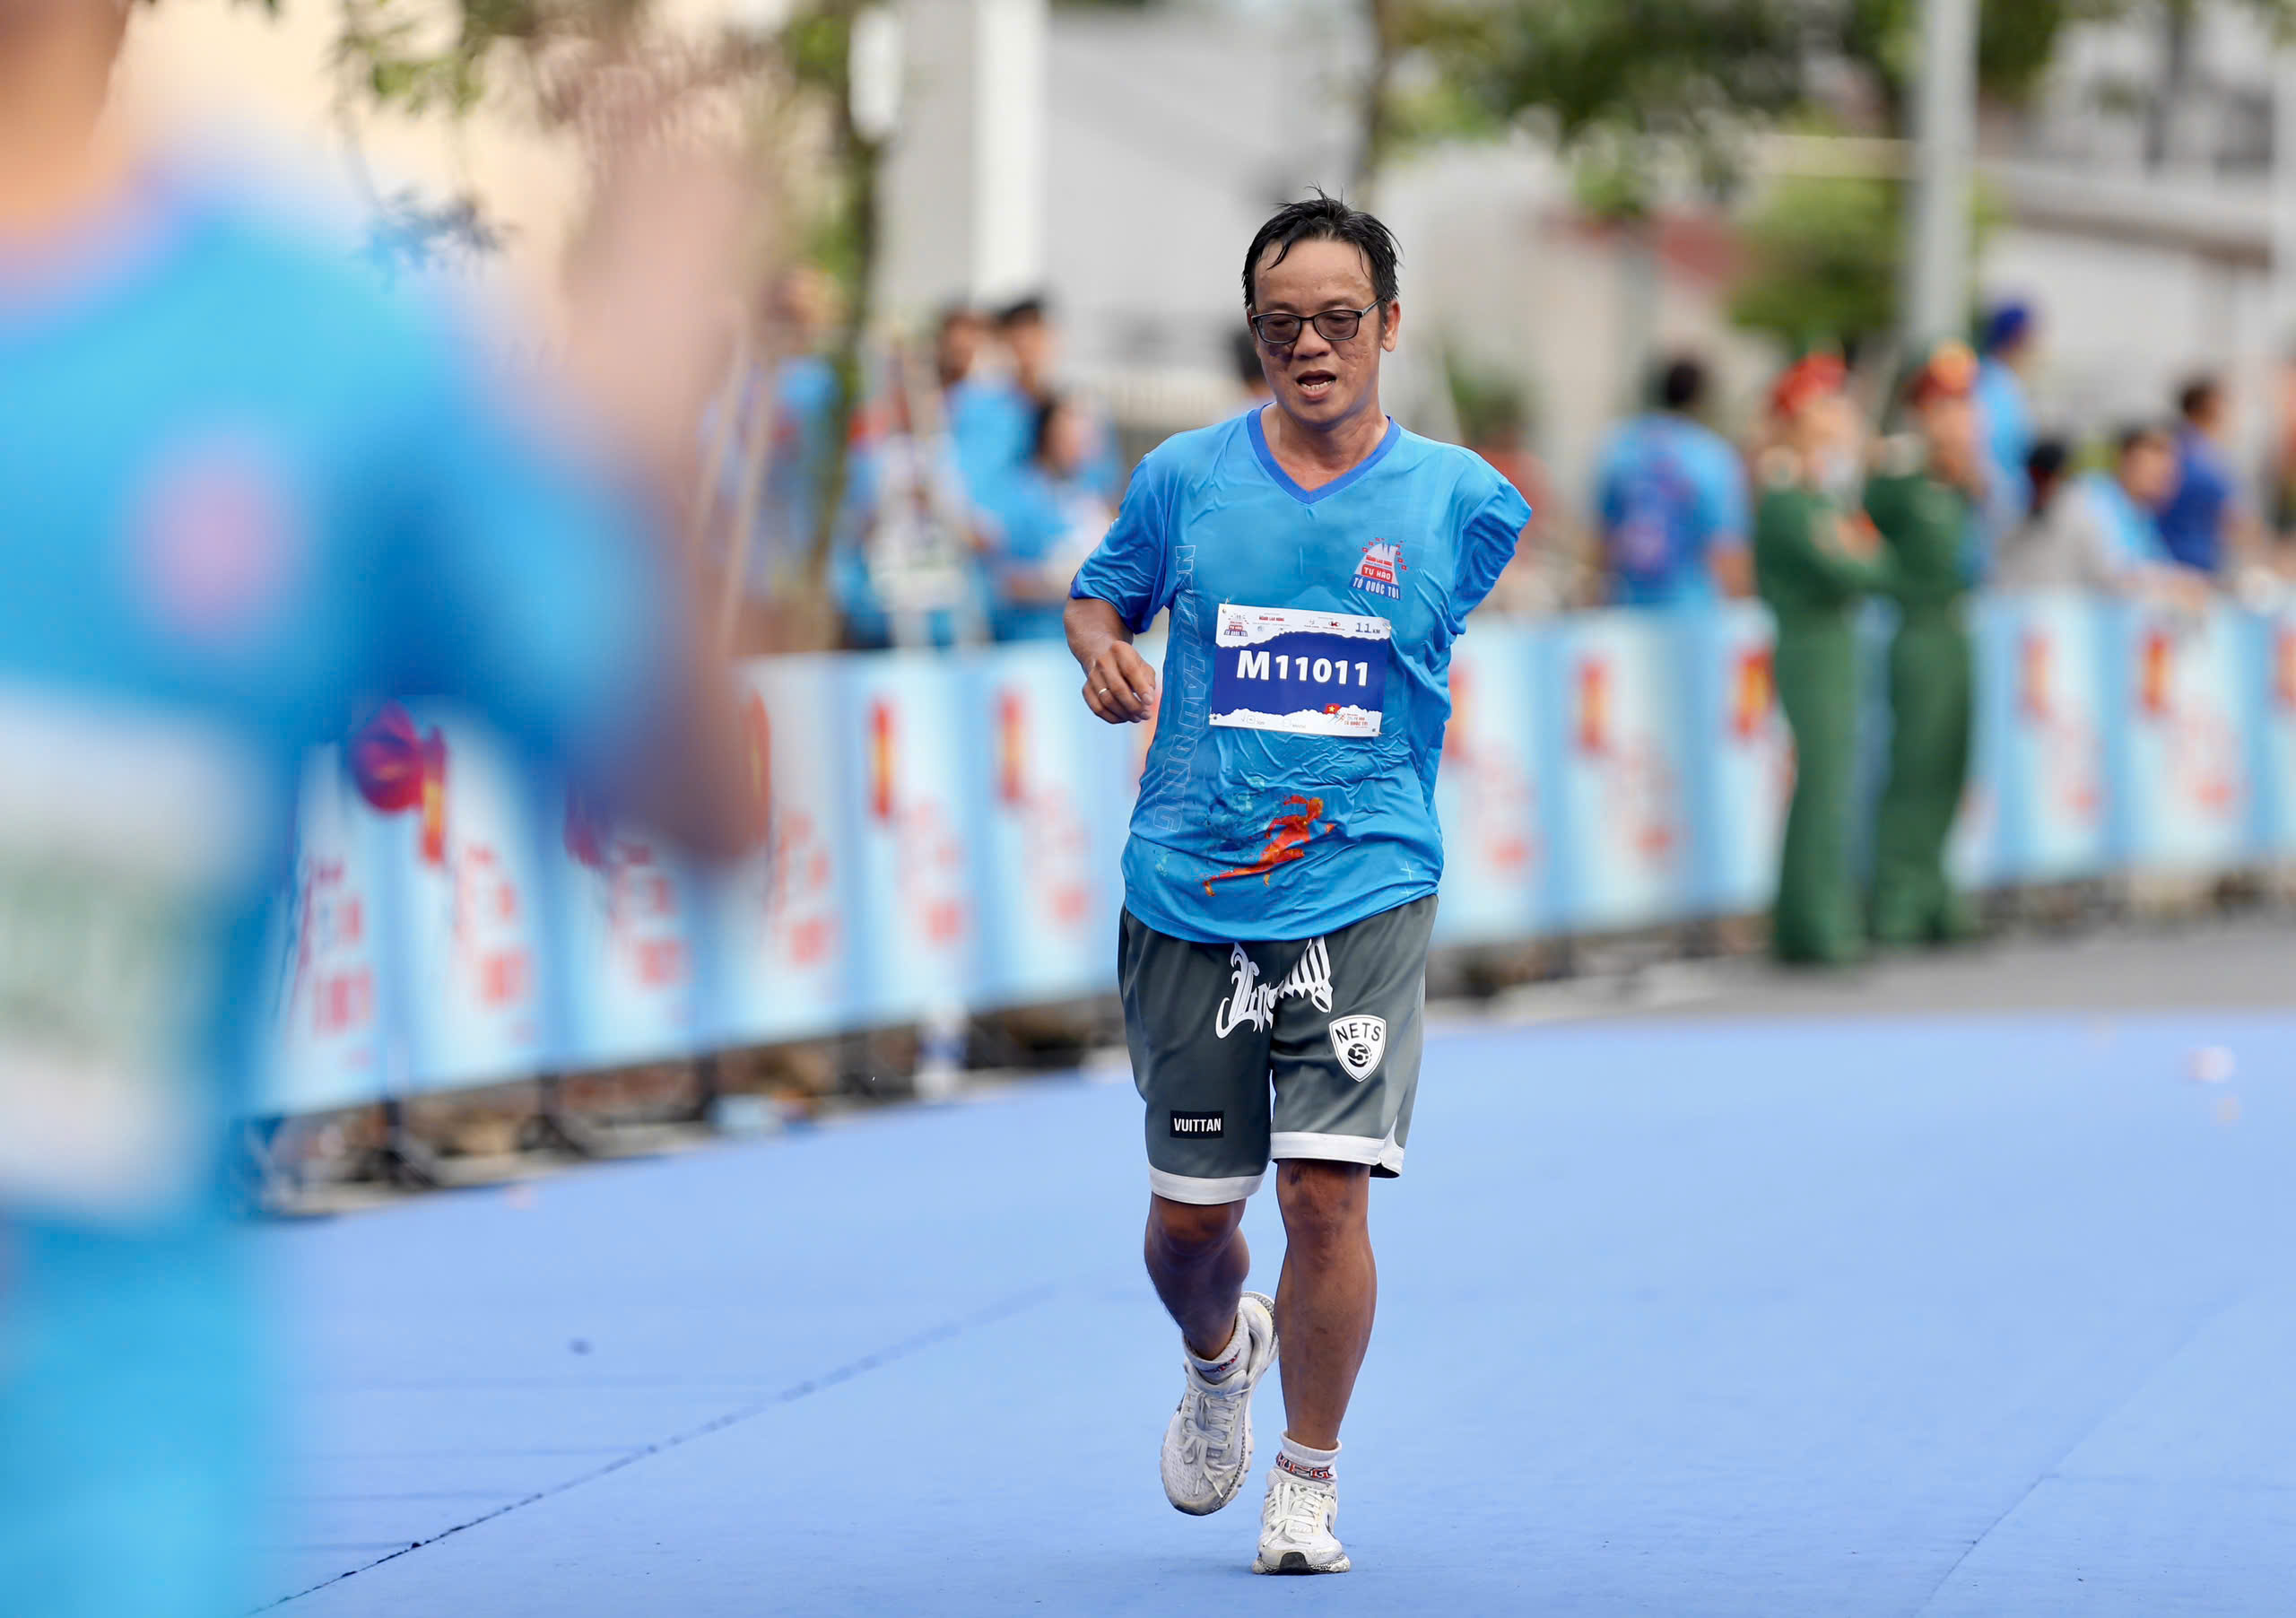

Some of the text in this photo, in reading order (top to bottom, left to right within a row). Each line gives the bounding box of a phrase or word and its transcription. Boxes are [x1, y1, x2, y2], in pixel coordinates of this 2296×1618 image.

[1355, 622, 1371, 633] 11
[1236, 649, 1369, 686] M11011
[1335, 1022, 1381, 1043] NETS
[1174, 1118, 1222, 1132] VUITTAN
